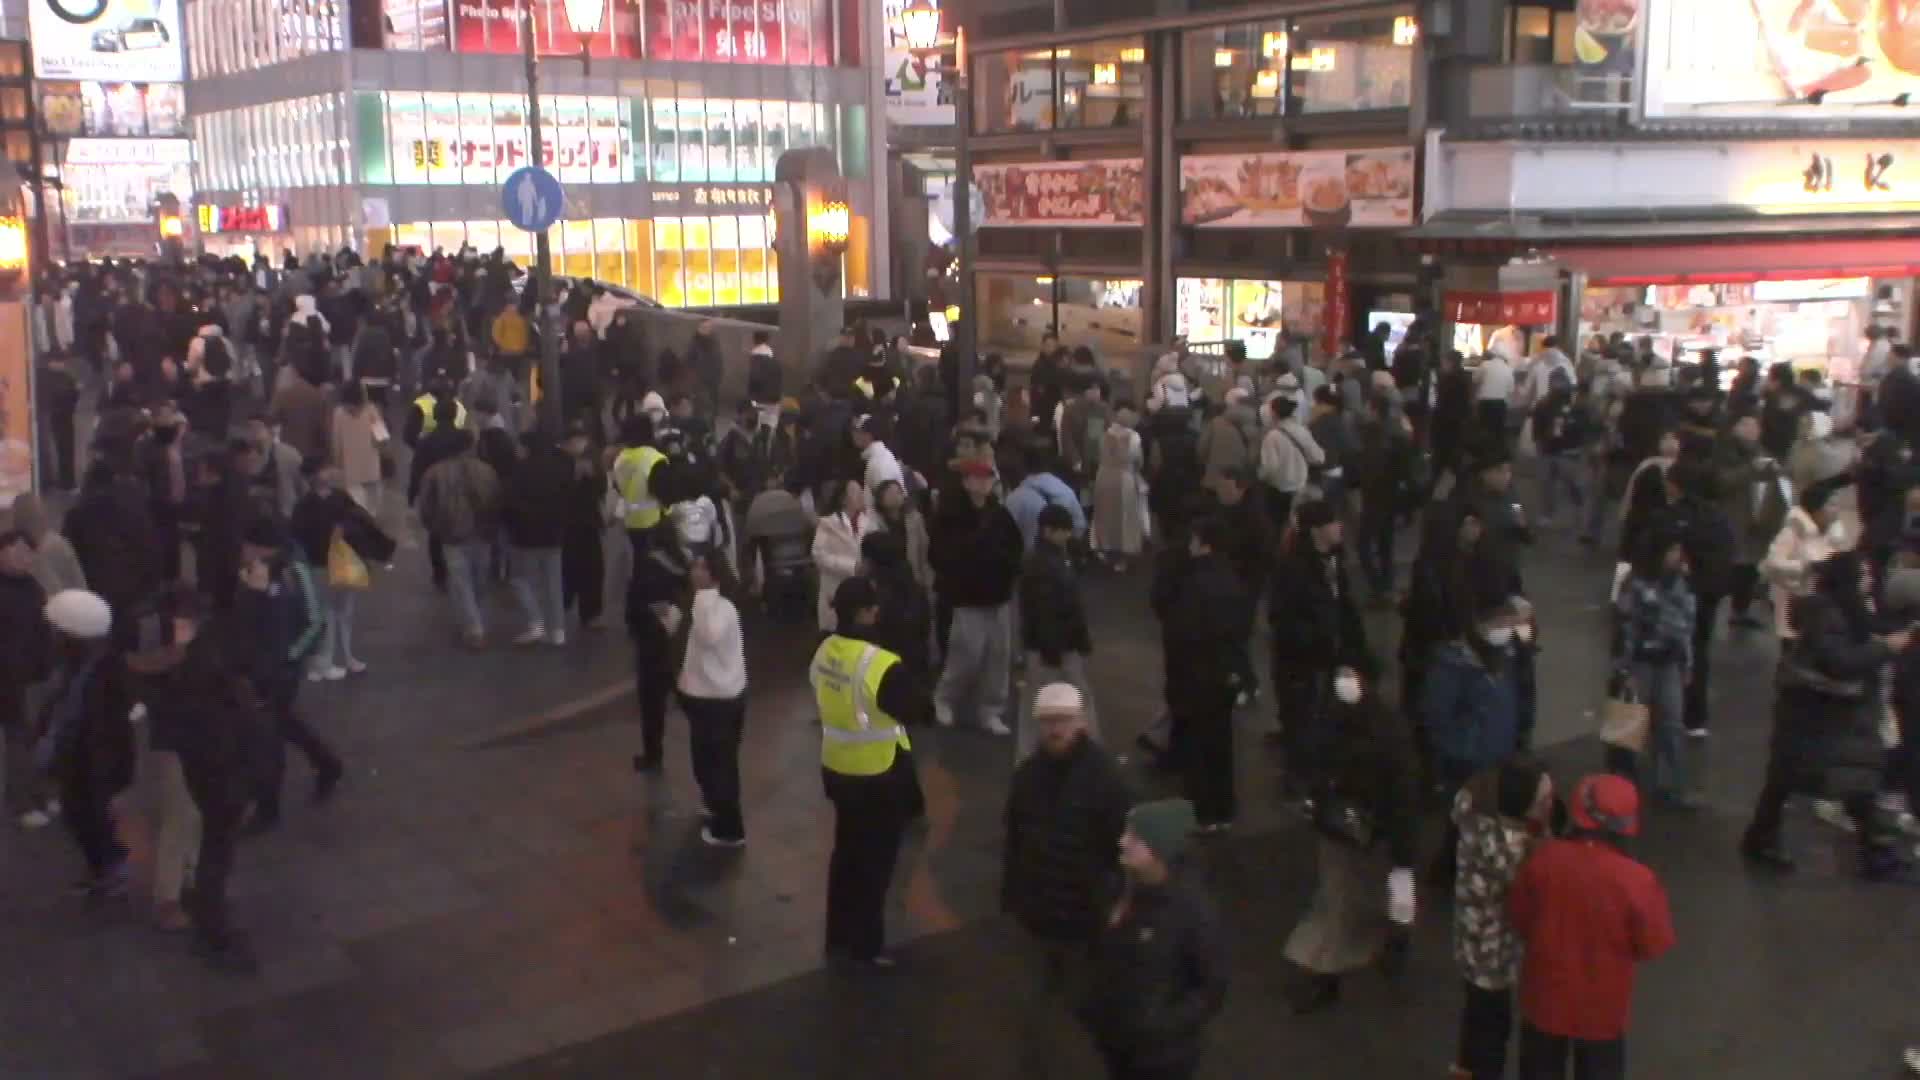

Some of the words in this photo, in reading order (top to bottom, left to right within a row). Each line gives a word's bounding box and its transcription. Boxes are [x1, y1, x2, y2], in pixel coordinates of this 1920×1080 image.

[460, 4, 499, 18] Photo
[709, 3, 753, 21] Free
[762, 2, 811, 28] Shop
[449, 139, 600, 168] サンドラッグ
